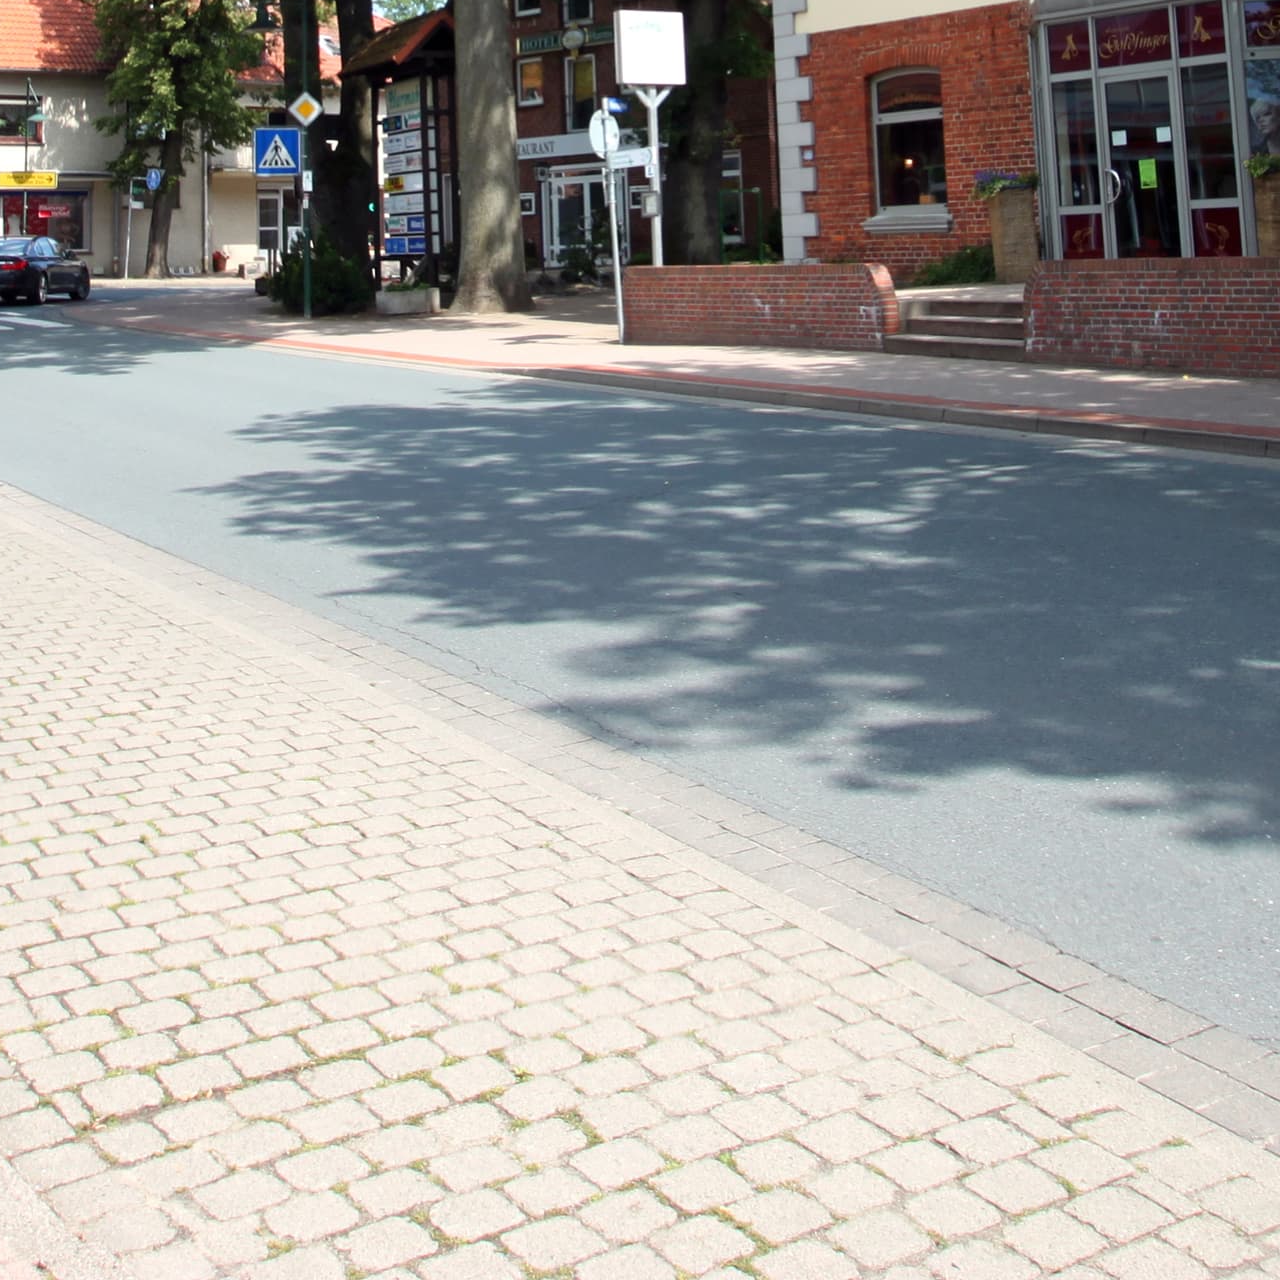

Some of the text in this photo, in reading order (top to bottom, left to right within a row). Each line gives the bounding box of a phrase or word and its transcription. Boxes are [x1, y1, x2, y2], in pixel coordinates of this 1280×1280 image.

[522, 35, 560, 50] HOTEL
[1098, 31, 1169, 58] Goldfinger
[516, 141, 555, 155] TAURANT
